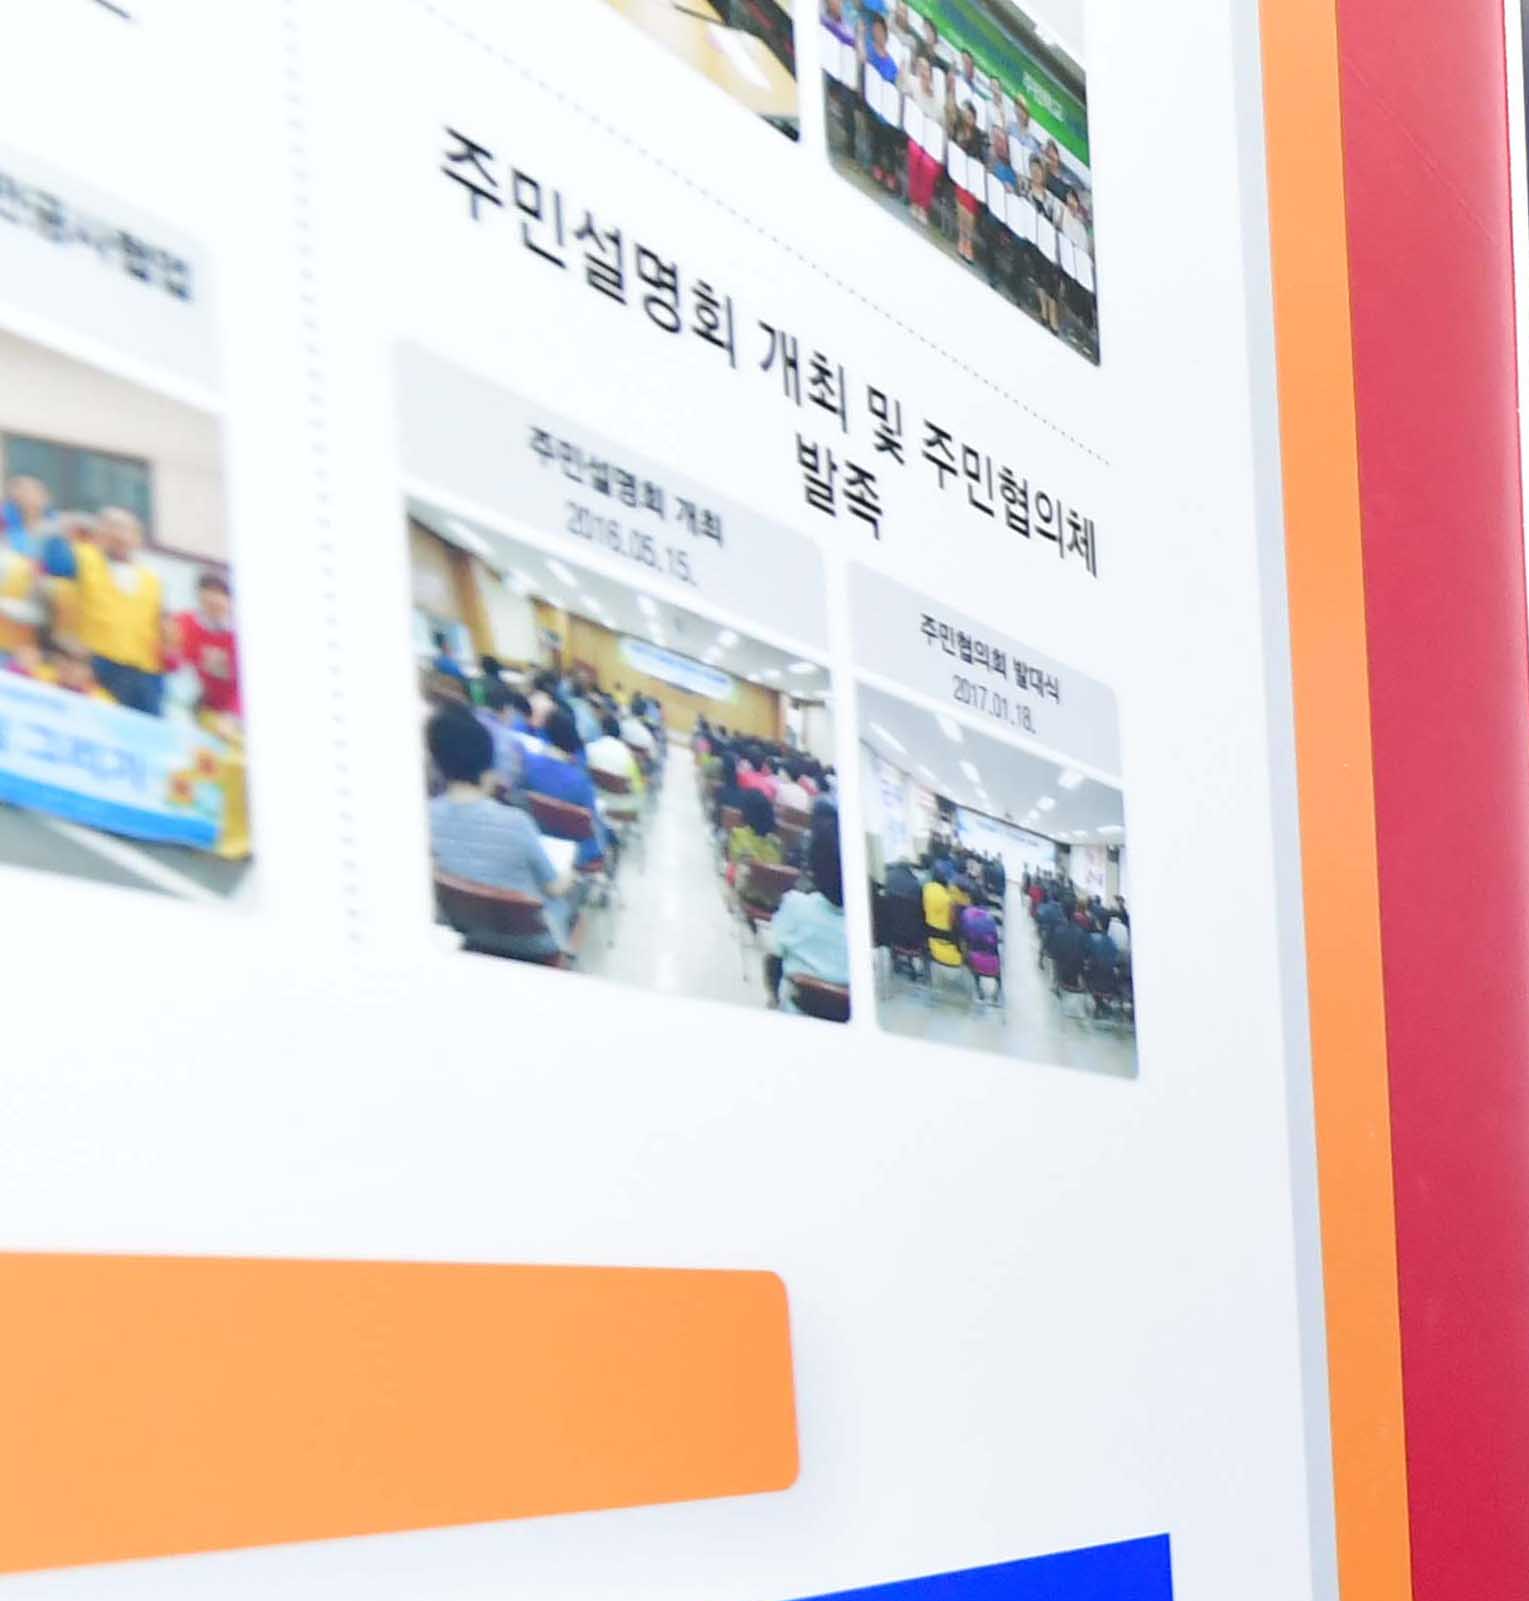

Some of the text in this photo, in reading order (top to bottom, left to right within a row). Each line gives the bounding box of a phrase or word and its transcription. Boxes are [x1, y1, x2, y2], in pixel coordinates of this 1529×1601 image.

[440, 125, 1099, 578] 주민설명회 개최 및 주민협의체
[529, 425, 723, 547] 주민설명회 개최
[796, 432, 882, 540] 발족
[920, 612, 1061, 704] 주민협의회 발대식
